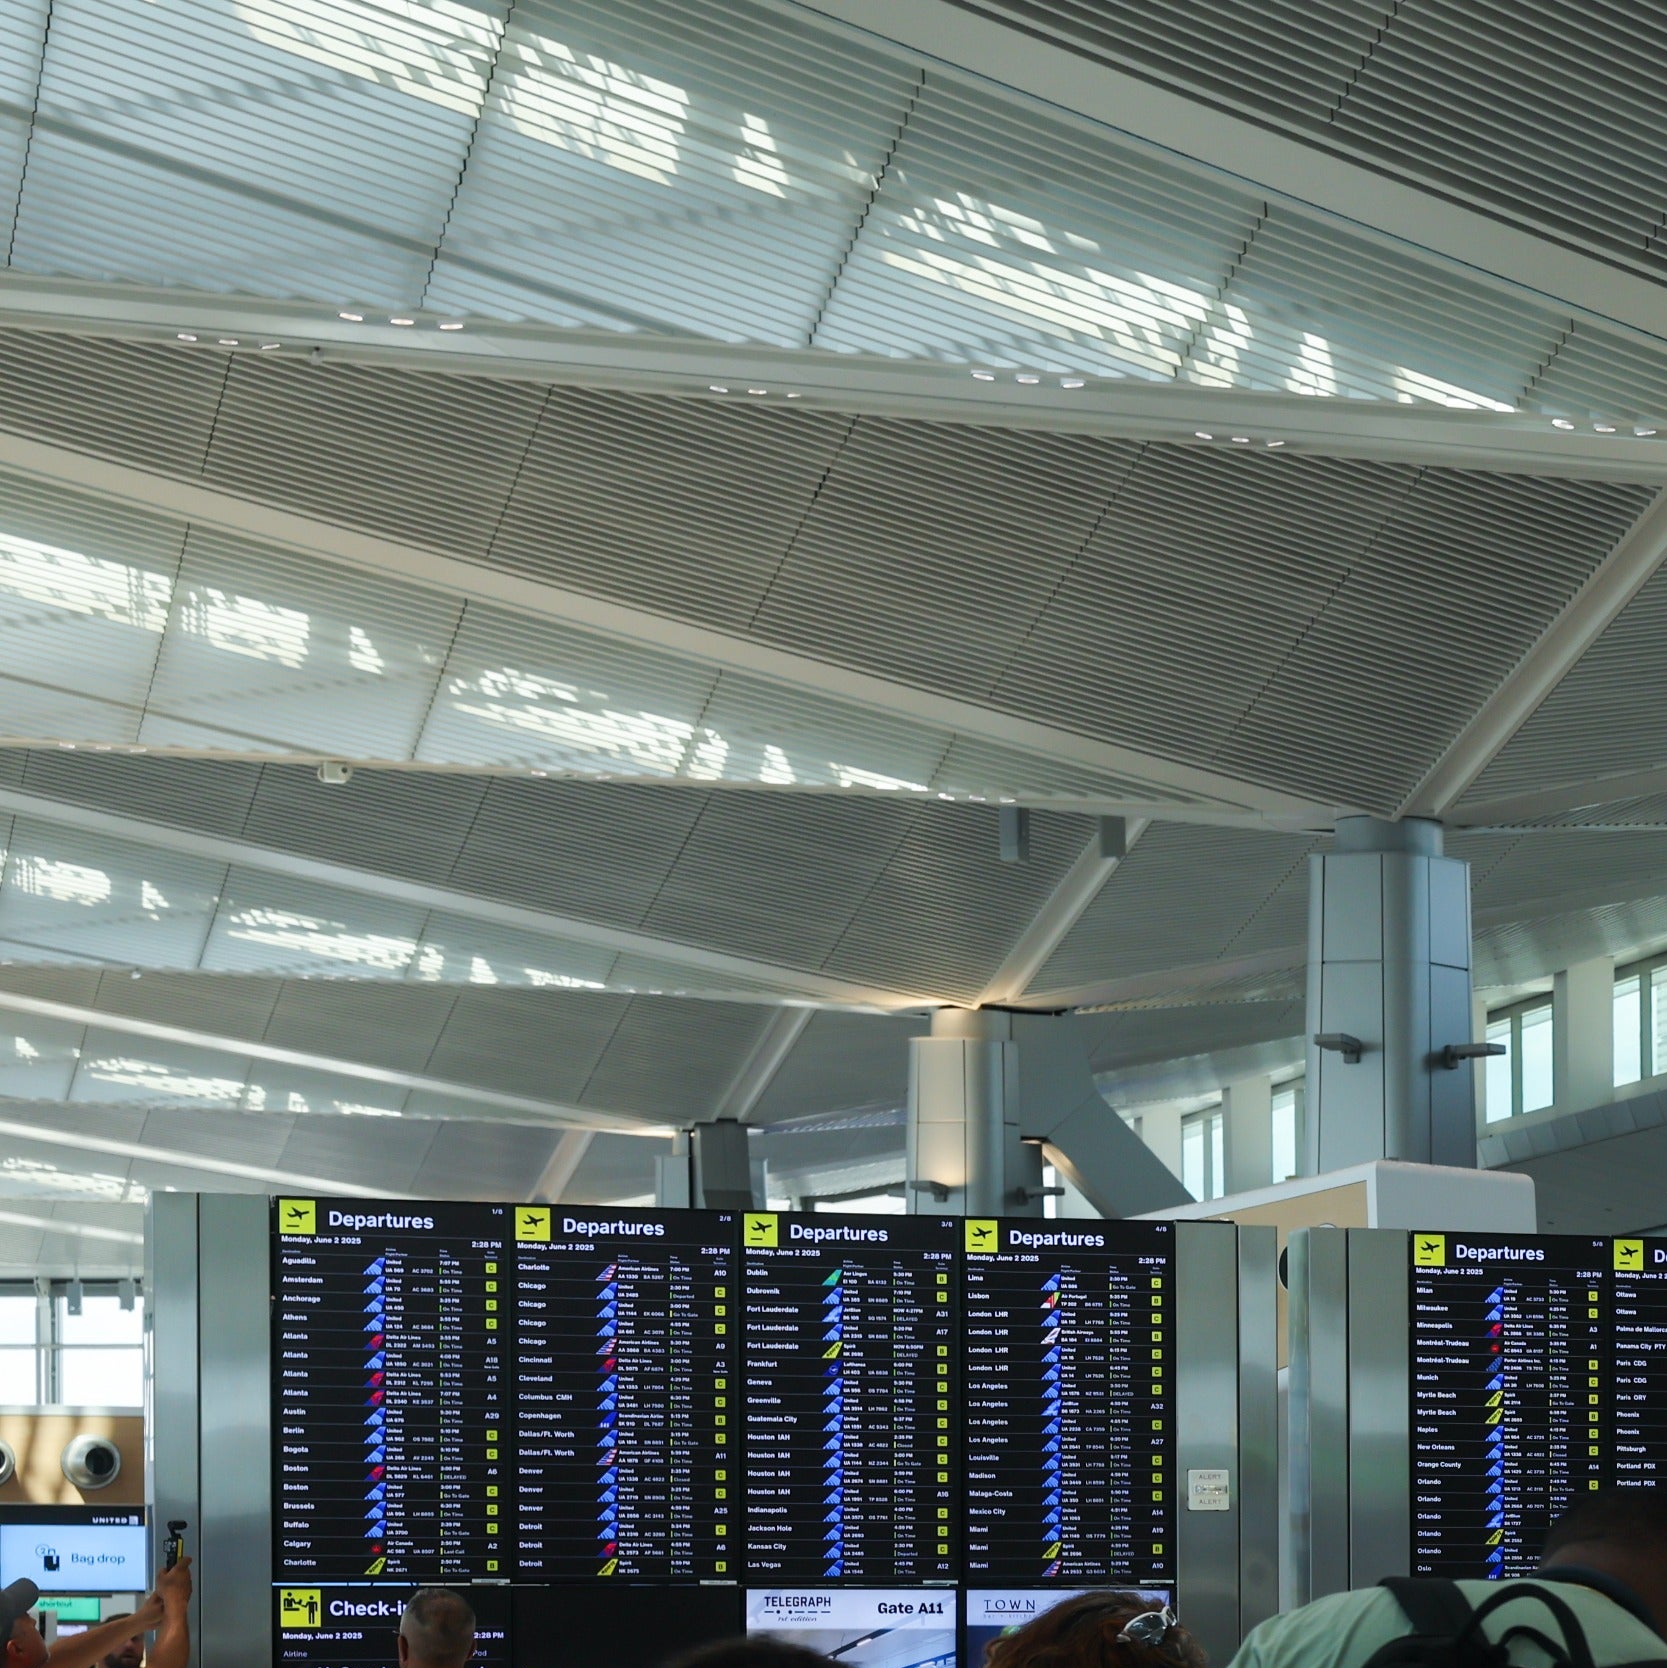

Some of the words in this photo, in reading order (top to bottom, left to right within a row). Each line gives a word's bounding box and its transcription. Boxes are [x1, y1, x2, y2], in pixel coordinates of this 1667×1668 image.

[329, 1211, 434, 1230] Departures
[563, 1217, 665, 1237] Departures
[790, 1224, 888, 1243] Departures
[281, 1236, 313, 1244] Monday,
[1009, 1229, 1105, 1248] Departures
[1455, 1244, 1545, 1262] Departures
[283, 1257, 315, 1266] Aguadilla
[747, 1269, 768, 1277] Dublin
[283, 1277, 323, 1285] Amsterdam
[968, 1274, 984, 1282] Lima
[968, 1292, 990, 1300] Lisbon
[1616, 1291, 1636, 1299] Ottawa
[1416, 1322, 1453, 1330] Minneapolis
[747, 1360, 777, 1368] Frankfurt
[519, 1375, 553, 1383] Cleveland
[519, 1412, 562, 1421] Copenhagen
[1418, 1478, 1441, 1486] Orlando
[283, 1502, 315, 1510] Brussels
[747, 1506, 788, 1515] Indianapolis
[284, 1540, 311, 1549] Calgary
[71, 1553, 94, 1565] Bag
[98, 1552, 126, 1565] drop
[764, 1596, 831, 1607] TELEGRAPH
[984, 1600, 1036, 1610] TOWN
[878, 1602, 914, 1614] Gate
[917, 1602, 944, 1614] A11
